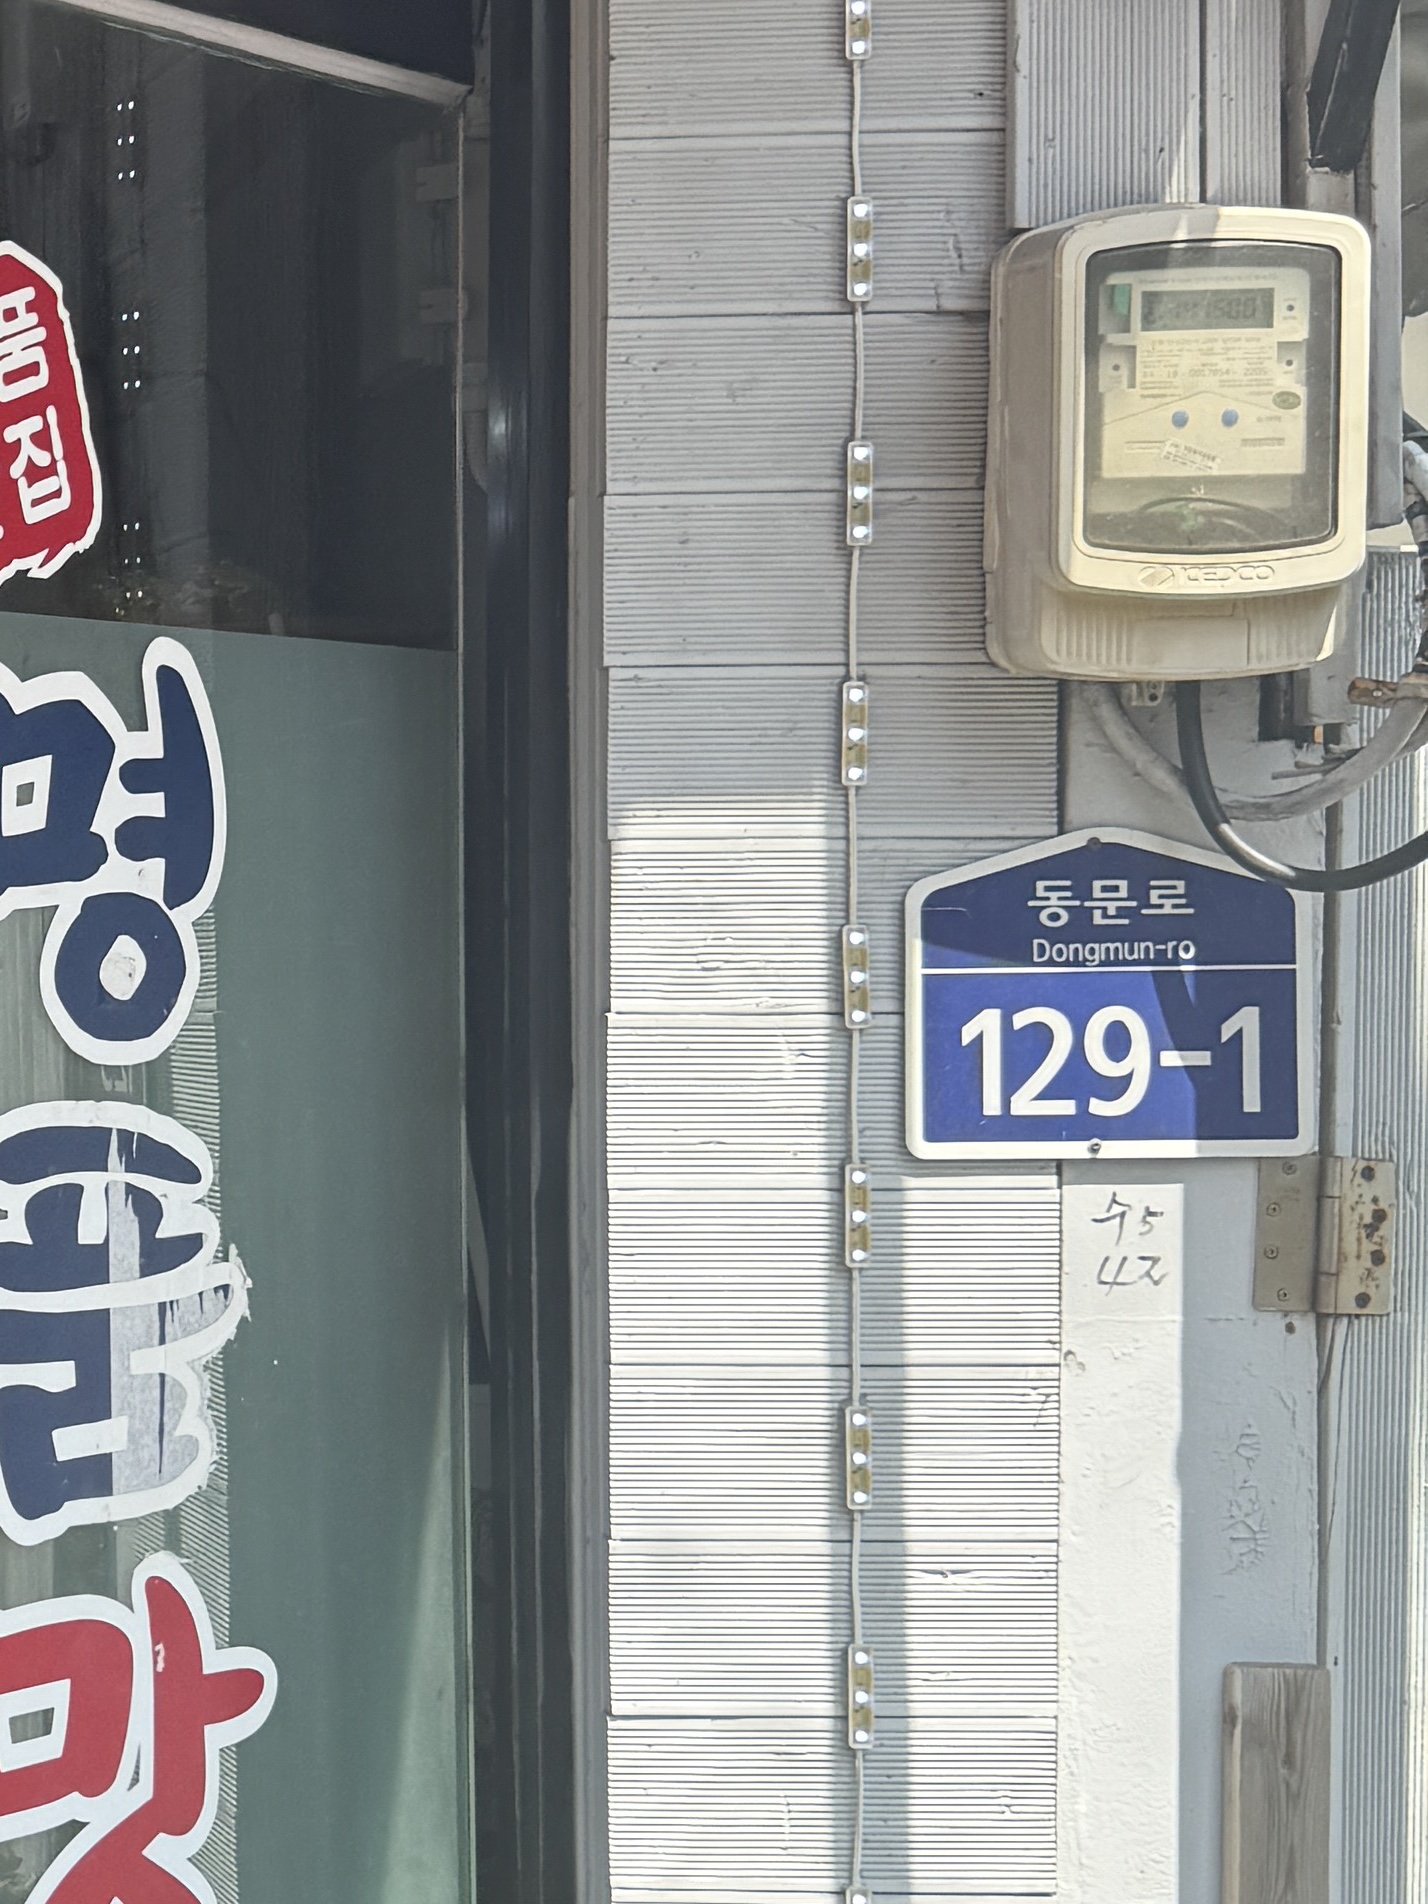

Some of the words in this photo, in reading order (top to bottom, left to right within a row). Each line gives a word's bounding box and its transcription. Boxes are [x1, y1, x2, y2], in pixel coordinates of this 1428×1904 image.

[1027, 879, 1195, 928] 동문로
[1032, 939, 1196, 965] Dongmun-ro
[960, 1004, 1262, 1117] 129-1
